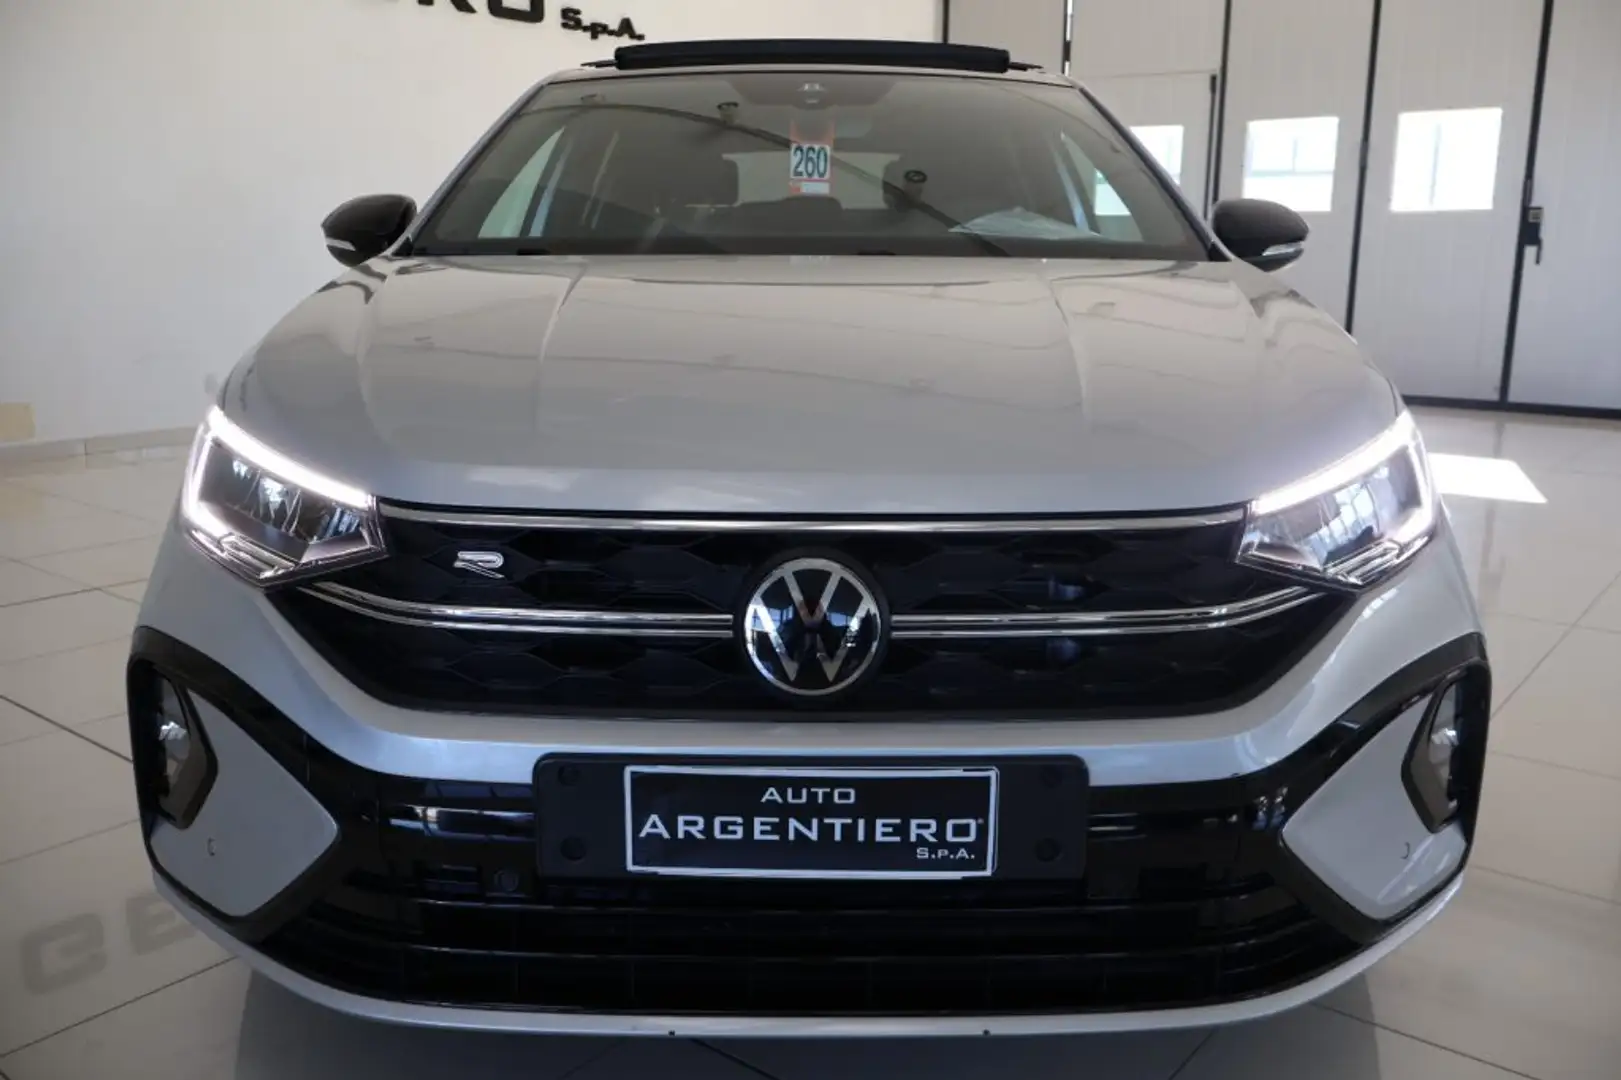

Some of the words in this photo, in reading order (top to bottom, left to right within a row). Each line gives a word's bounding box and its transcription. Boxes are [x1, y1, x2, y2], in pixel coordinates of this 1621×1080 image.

[793, 145, 828, 179] 260
[760, 786, 856, 804] AUTO
[638, 813, 978, 843] ARGENTIERO
